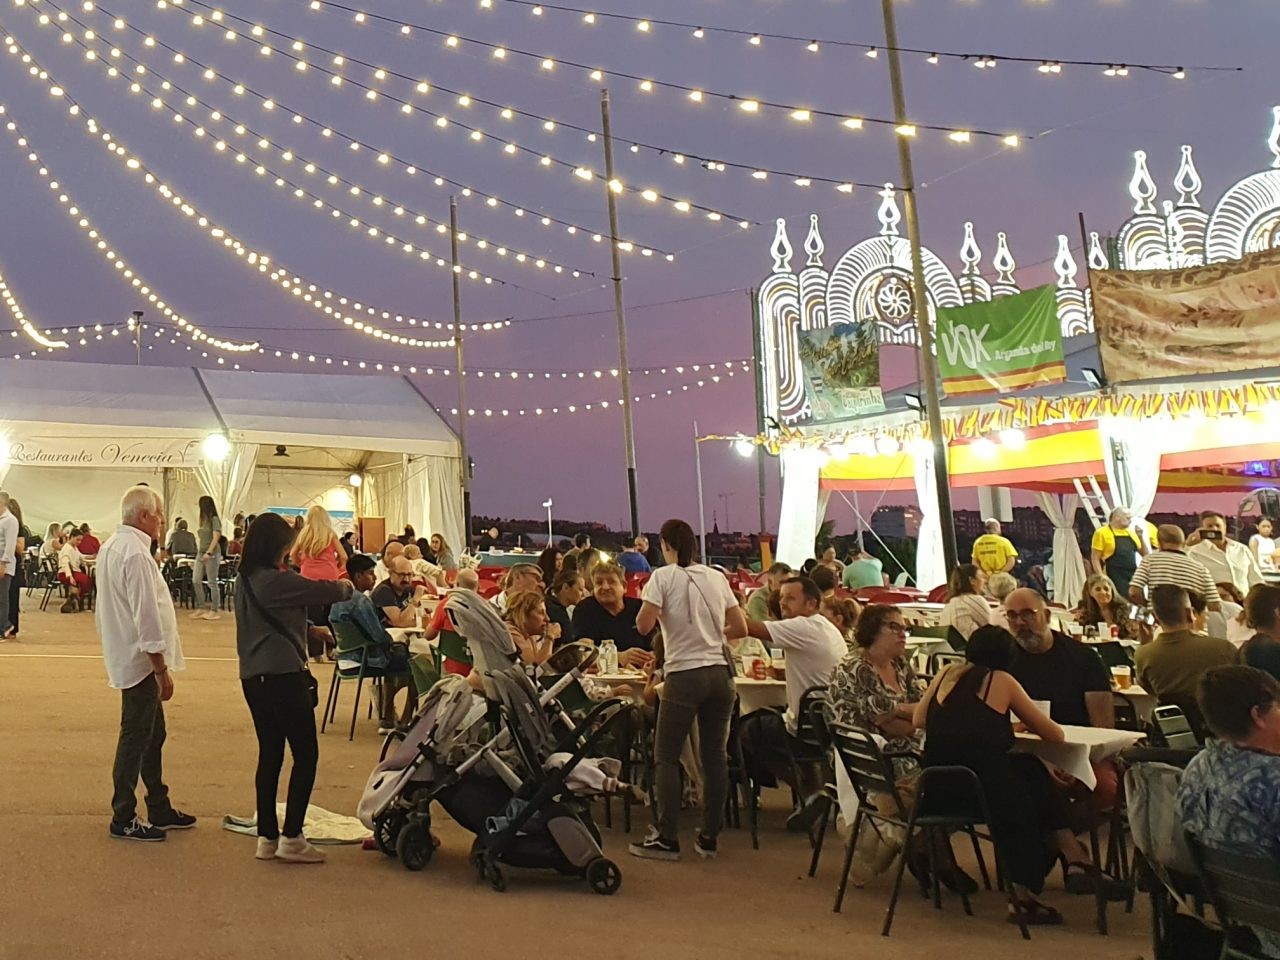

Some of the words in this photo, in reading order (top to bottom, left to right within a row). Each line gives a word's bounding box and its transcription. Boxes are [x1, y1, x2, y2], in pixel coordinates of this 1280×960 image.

[995, 345, 1031, 361] Arganda
[8, 442, 93, 462] Restaurantes
[100, 442, 173, 464] Venecia
